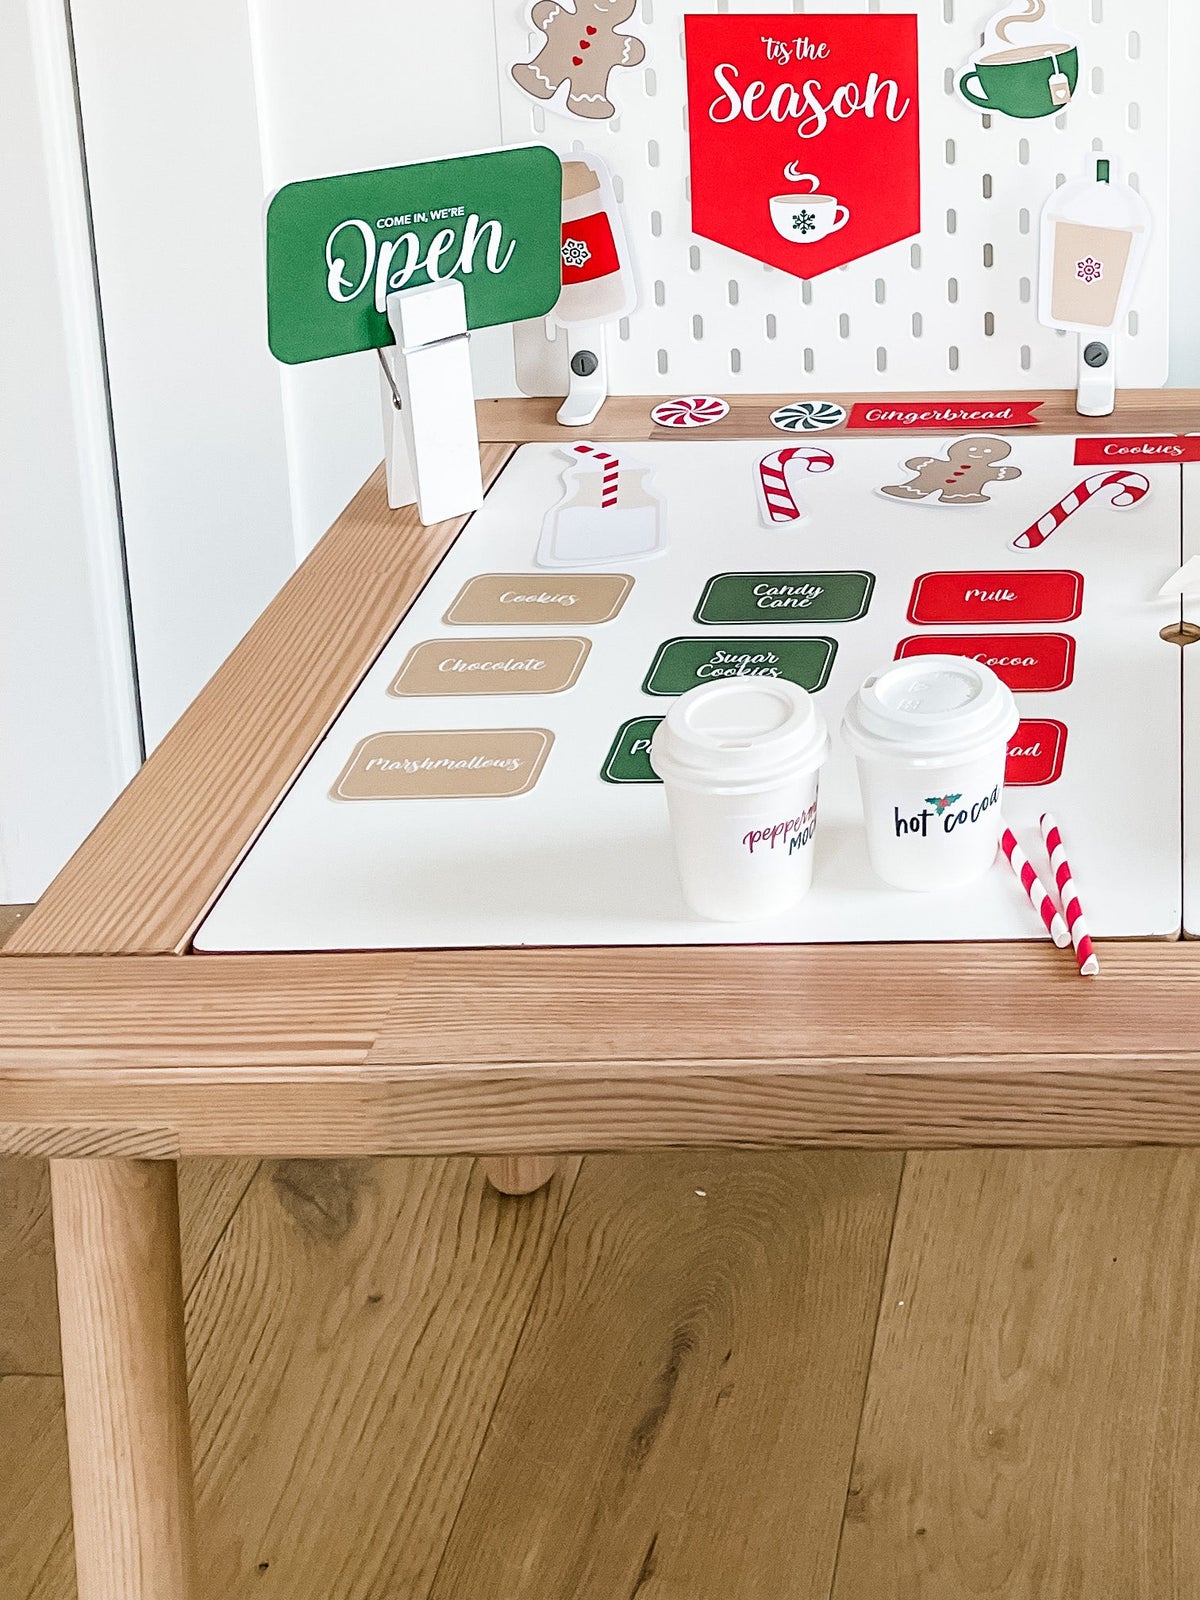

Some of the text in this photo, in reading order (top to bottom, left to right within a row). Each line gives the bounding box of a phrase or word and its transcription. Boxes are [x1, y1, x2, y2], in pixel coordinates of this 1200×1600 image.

[761, 34, 830, 64] 'tis the
[709, 61, 909, 138] Season
[377, 206, 464, 228] COME IN, WE'RE
[326, 214, 516, 313] Open
[865, 404, 1013, 425] Gingerbread
[1103, 442, 1185, 458] Cookies
[500, 591, 579, 607] Cookies
[754, 584, 824, 602] Candy
[965, 589, 1018, 602] Milk
[757, 596, 813, 609] Cane
[438, 657, 546, 673] Chocolate
[710, 650, 779, 671] Sugar
[696, 663, 782, 678] Cookies
[366, 756, 525, 773] Marshmallows
[895, 784, 999, 837] hot cocoa
